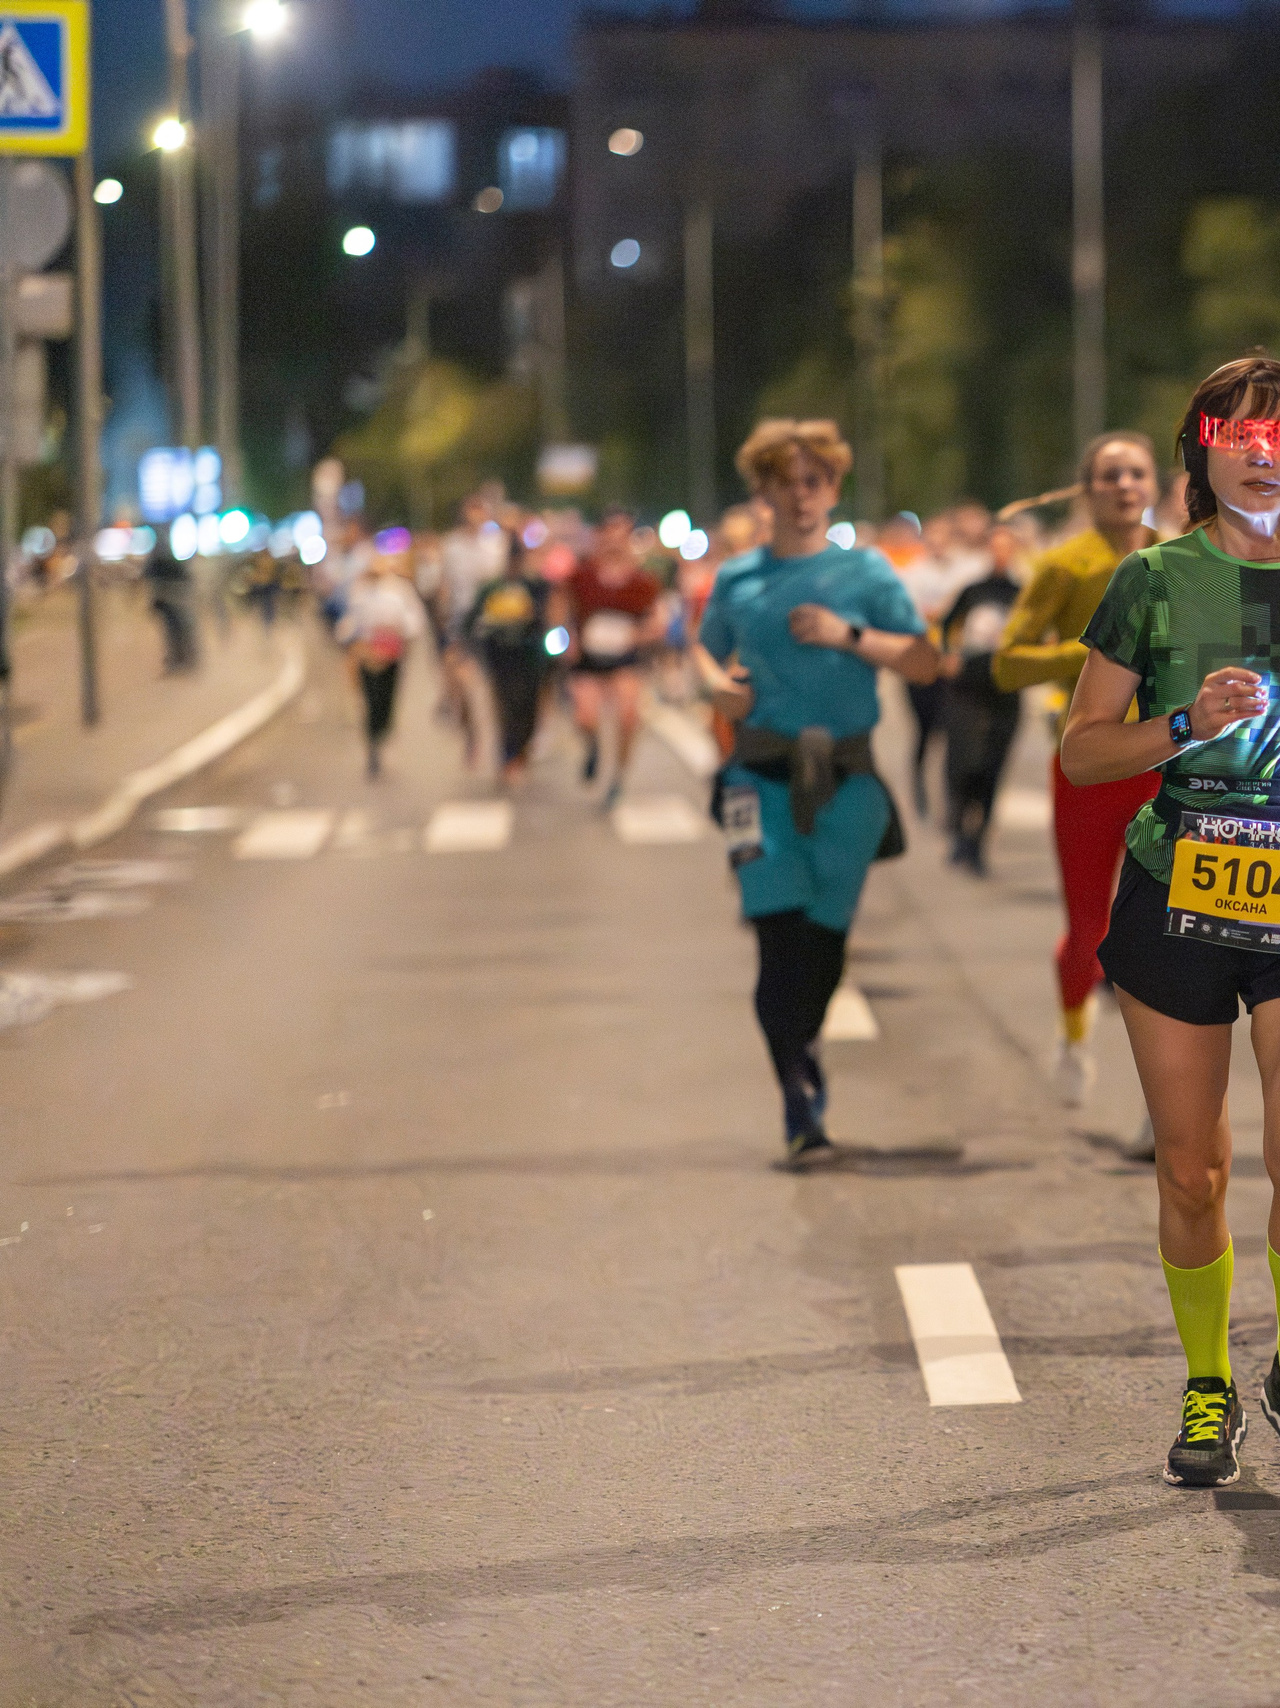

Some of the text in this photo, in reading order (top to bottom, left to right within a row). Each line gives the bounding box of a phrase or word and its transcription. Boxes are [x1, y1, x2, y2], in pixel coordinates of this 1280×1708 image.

[1188, 778, 1228, 791] ЭРА
[1215, 898, 1268, 915] ОКСАНА
[1180, 914, 1197, 934] F
